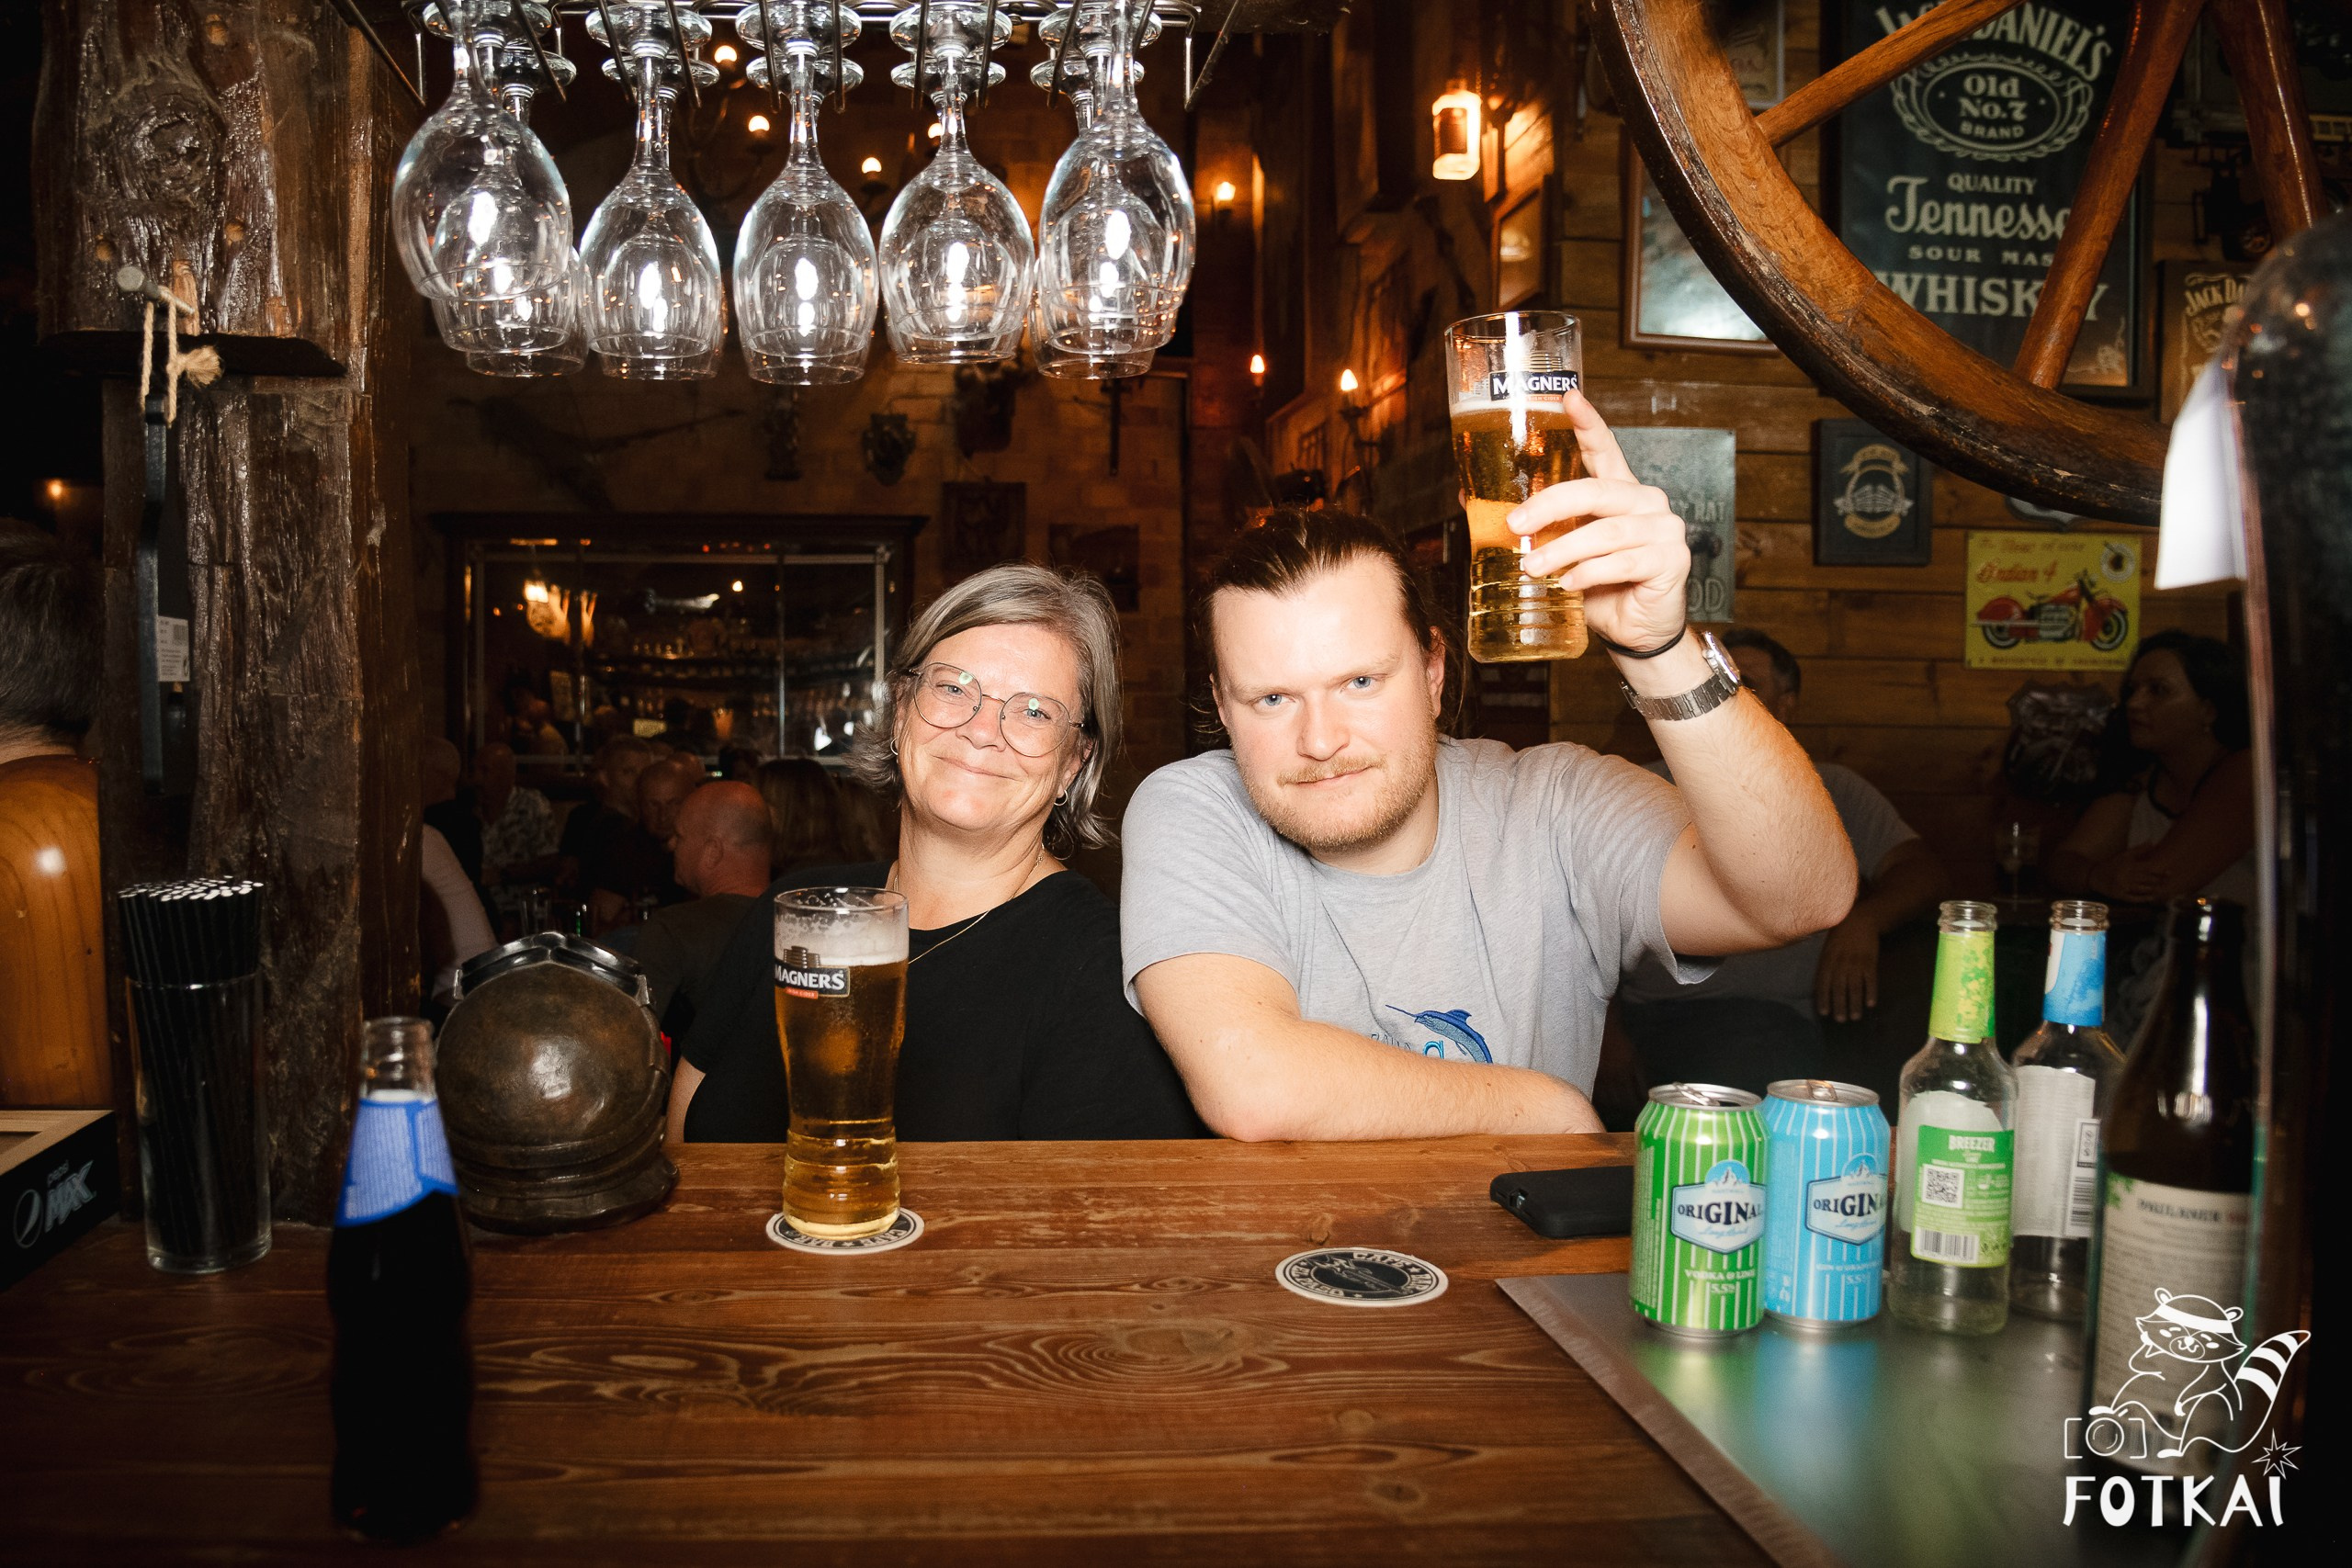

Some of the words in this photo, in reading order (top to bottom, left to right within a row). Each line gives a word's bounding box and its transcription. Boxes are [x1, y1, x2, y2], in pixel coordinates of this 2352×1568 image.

[1962, 73, 2020, 98] Old
[1958, 96, 2029, 122] No.7
[1959, 120, 2025, 139] BRAND
[1946, 172, 2038, 196] QUALITY
[1884, 175, 2073, 242] Tennesse
[1907, 244, 1982, 264] SOUR
[2001, 250, 2057, 267] MAS
[1872, 270, 2109, 321] WHISKY
[1492, 374, 1578, 396] MAGNERS
[775, 963, 846, 991] MAGNERS
[44, 1159, 97, 1234] MAX
[1352, 1251, 1407, 1269] CAFE
[1684, 1269, 1724, 1280] VODKA
